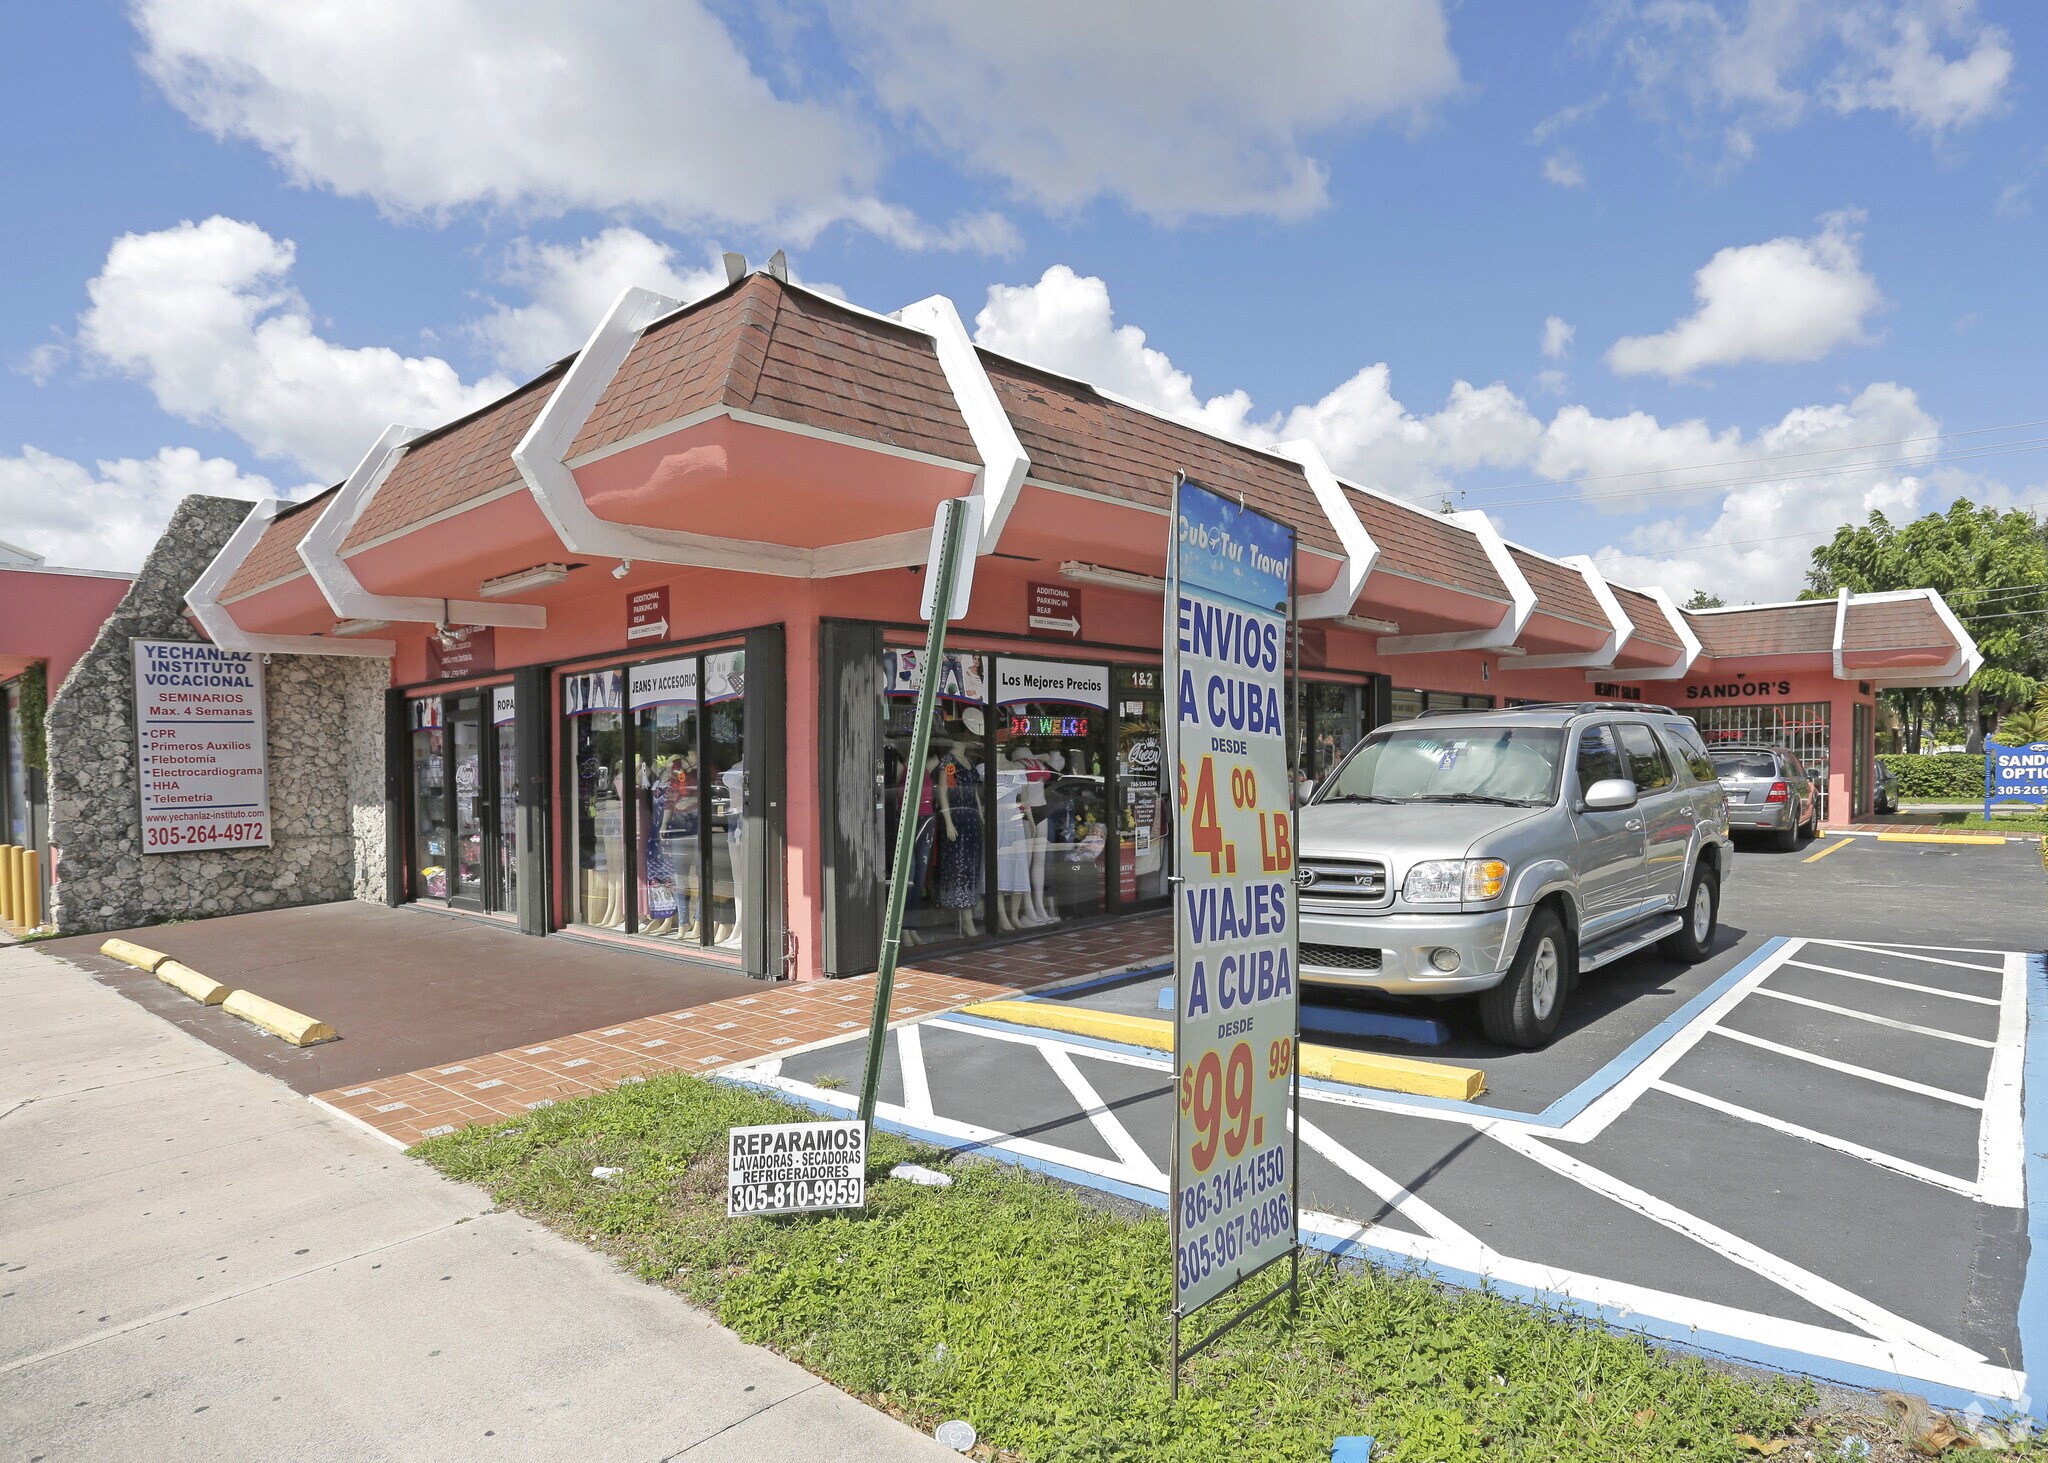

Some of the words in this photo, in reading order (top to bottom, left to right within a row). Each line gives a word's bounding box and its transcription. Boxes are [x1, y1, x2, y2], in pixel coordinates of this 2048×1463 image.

[1249, 543, 1289, 580] Travel
[633, 591, 660, 604] ADDITIONAL
[1036, 587, 1069, 598] ADDITIONAL
[633, 603, 652, 614] PARKING
[653, 602, 659, 610] IN
[1036, 597, 1060, 607] PARKING
[1036, 606, 1052, 615] REAR
[633, 615, 645, 624] REAR
[1179, 597, 1278, 673] ENVIOS
[143, 645, 253, 662] YECHANLAZ
[151, 661, 247, 675] INSTITUTO
[145, 674, 254, 688] VOCACIONAL
[632, 677, 652, 694] JEANS
[652, 678, 658, 690] Y
[658, 673, 696, 690] ACCESORIO
[1002, 673, 1021, 687] Los
[1023, 675, 1064, 690] Mejores
[1066, 677, 1102, 691] Precios
[1132, 671, 1153, 686] 1&2
[1686, 681, 1791, 700] SANDOR'S
[159, 693, 244, 703] SEMINARIOS
[497, 699, 515, 711] ROPA
[1179, 669, 1200, 724] A
[1207, 675, 1282, 737] CUBA
[149, 706, 180, 716] Max.
[184, 707, 191, 716] 4
[195, 706, 253, 716] Semanas
[150, 729, 176, 739] CPR
[1718, 731, 1745, 740] OPEN
[151, 742, 204, 751] Primeros
[206, 741, 251, 751] Auxilios
[1211, 736, 1248, 755] DESDE
[1998, 754, 2048, 767] SAND
[152, 767, 263, 778] Electrocardiograma
[153, 782, 180, 790] HHA
[146, 810, 265, 823] www.yechanlaz-instituto.com
[148, 823, 263, 846] 305-264-4972
[1259, 811, 1292, 873] LB
[1355, 876, 1373, 886] V8
[1187, 882, 1286, 944] VIAJES
[1188, 961, 1209, 1018] A
[1218, 947, 1292, 1010] CUBA
[1217, 1017, 1254, 1040] DESDE
[733, 1128, 861, 1157] REPARAMOS
[732, 1153, 793, 1172] LAVADORAS
[801, 1150, 861, 1167] SECADORAS
[742, 1165, 849, 1184] REFRIGERADORES
[733, 1179, 859, 1212] 305-810-9959
[1178, 1193, 1290, 1290] 305-967-8486
